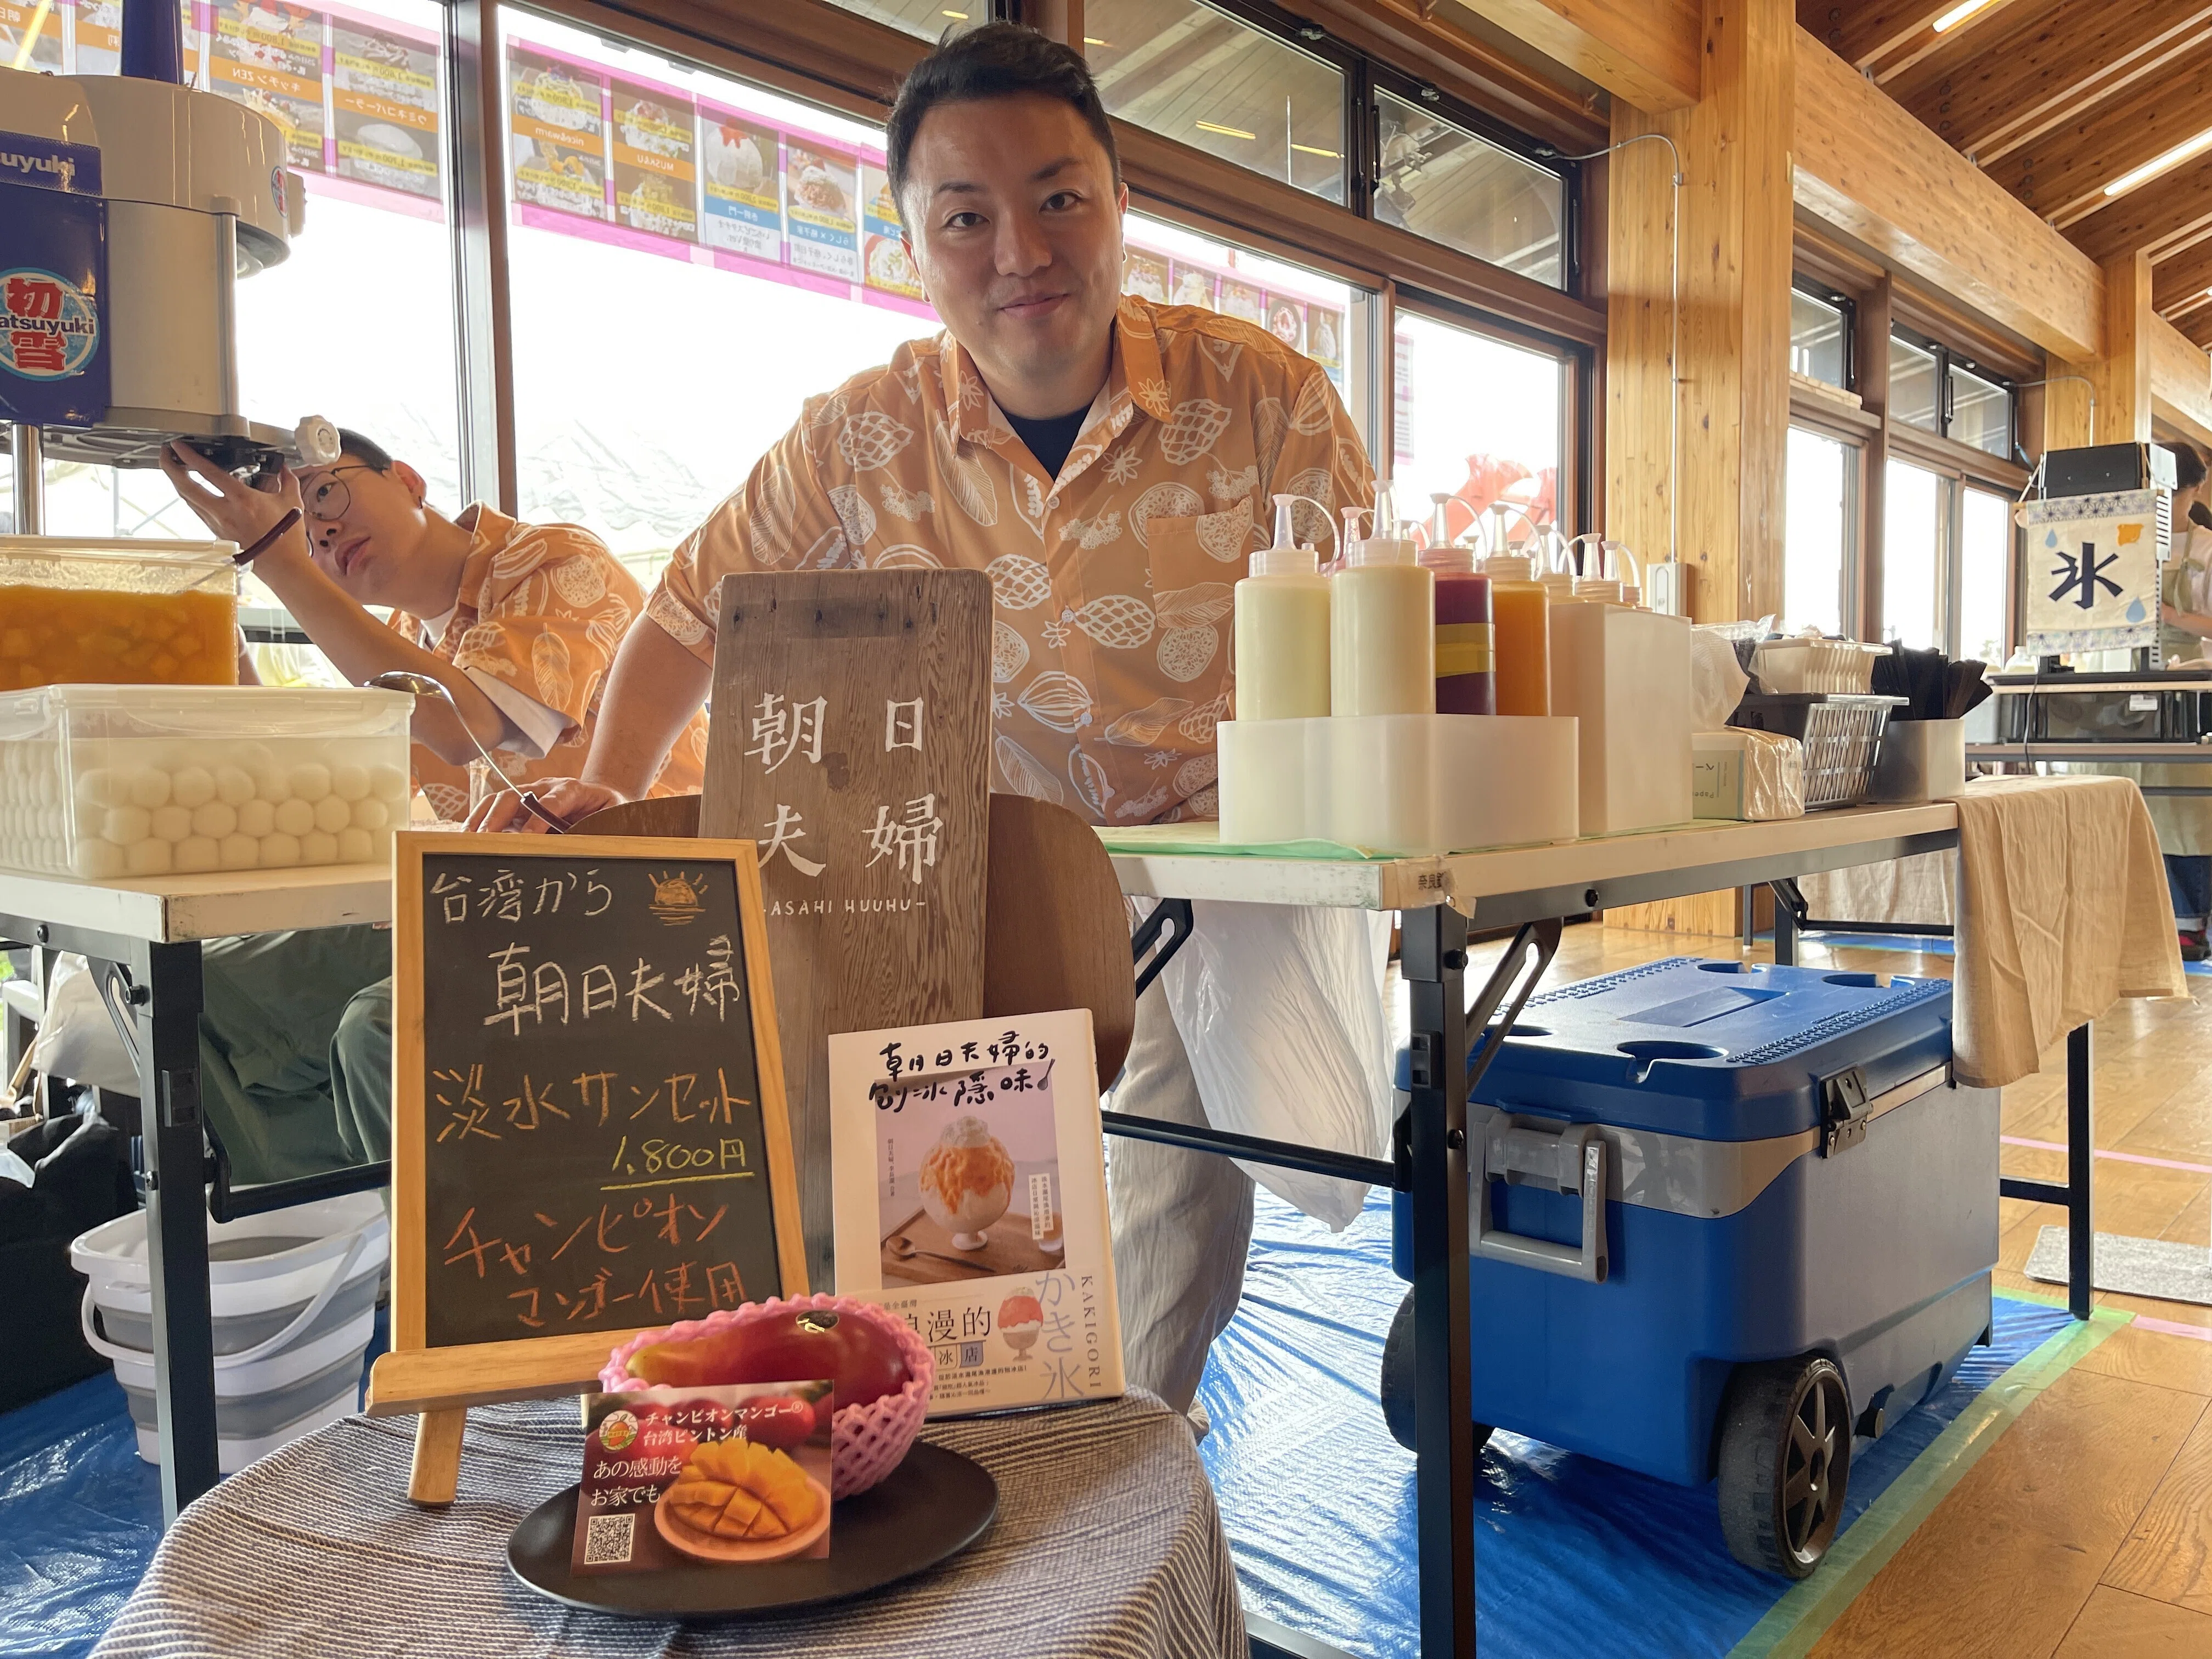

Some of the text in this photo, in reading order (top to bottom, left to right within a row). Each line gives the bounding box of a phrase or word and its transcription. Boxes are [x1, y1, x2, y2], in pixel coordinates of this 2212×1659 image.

[0, 152, 76, 176] uyuki
[2048, 541, 2124, 610] 氷
[743, 692, 924, 775] 朝日
[1692, 790, 1715, 799] Pape
[759, 792, 944, 885] 夫婦
[430, 868, 612, 924] 台湾から
[483, 933, 741, 1036] 朝日夫婦
[879, 1030, 1049, 1082] 朝日夫婦的
[432, 1063, 752, 1143] 淡水サンセット
[443, 1198, 729, 1279] チャンピオン
[507, 1260, 748, 1327] マンゴー使用
[1035, 1271, 1086, 1401] かき氷
[1080, 1274, 1103, 1390] KAKIGORI
[590, 1484, 662, 1508] お家でも
[592, 1455, 683, 1480] あの感動を
